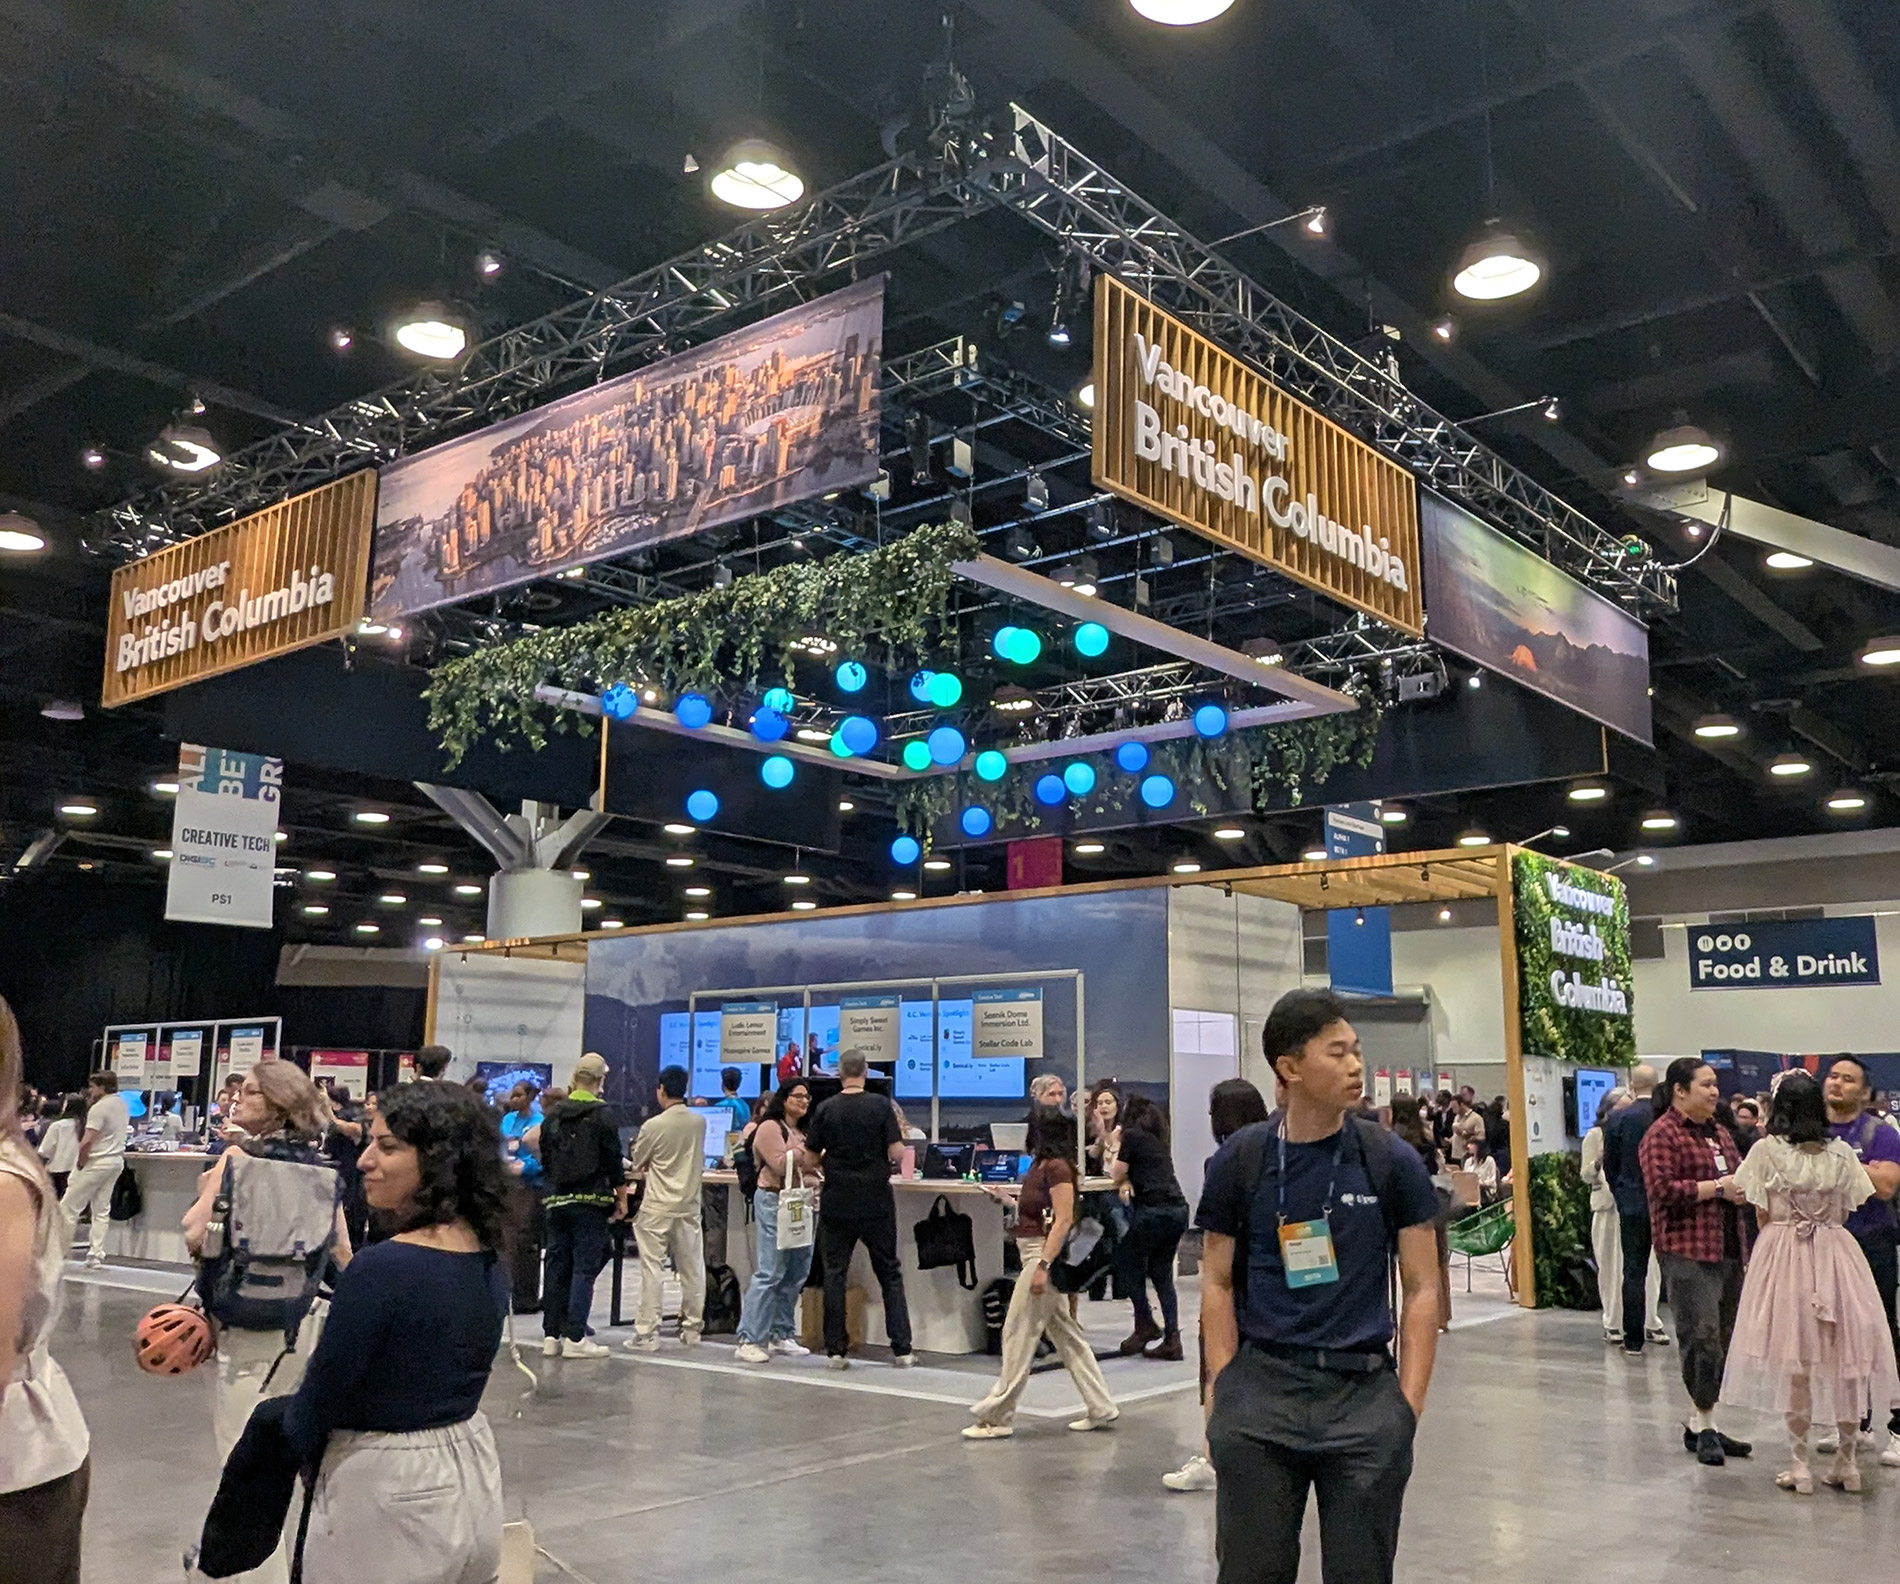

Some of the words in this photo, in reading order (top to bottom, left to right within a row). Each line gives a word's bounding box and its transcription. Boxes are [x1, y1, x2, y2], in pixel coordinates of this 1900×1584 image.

[1134, 333, 1289, 462] Vancouver
[1135, 400, 1256, 514] British
[1262, 476, 1408, 592] Columbia
[123, 561, 230, 620] Vancouver
[116, 610, 197, 672] British
[202, 564, 336, 642] Columbia
[181, 827, 238, 849] CREATIVE
[242, 835, 270, 852] TECH
[212, 893, 232, 905] PS1
[1545, 871, 1614, 916] Vancouver
[1550, 916, 1604, 960] British
[1698, 956, 1761, 980] Food
[1769, 956, 1790, 978] &
[1797, 952, 1868, 976] Drink
[1006, 1009, 1028, 1018] Dome
[1551, 970, 1628, 1014] Columbia
[852, 1025, 873, 1033] Games
[978, 1040, 1000, 1049] Stellar
[1000, 1039, 1019, 1048] Code
[1020, 1039, 1034, 1047] Lab
